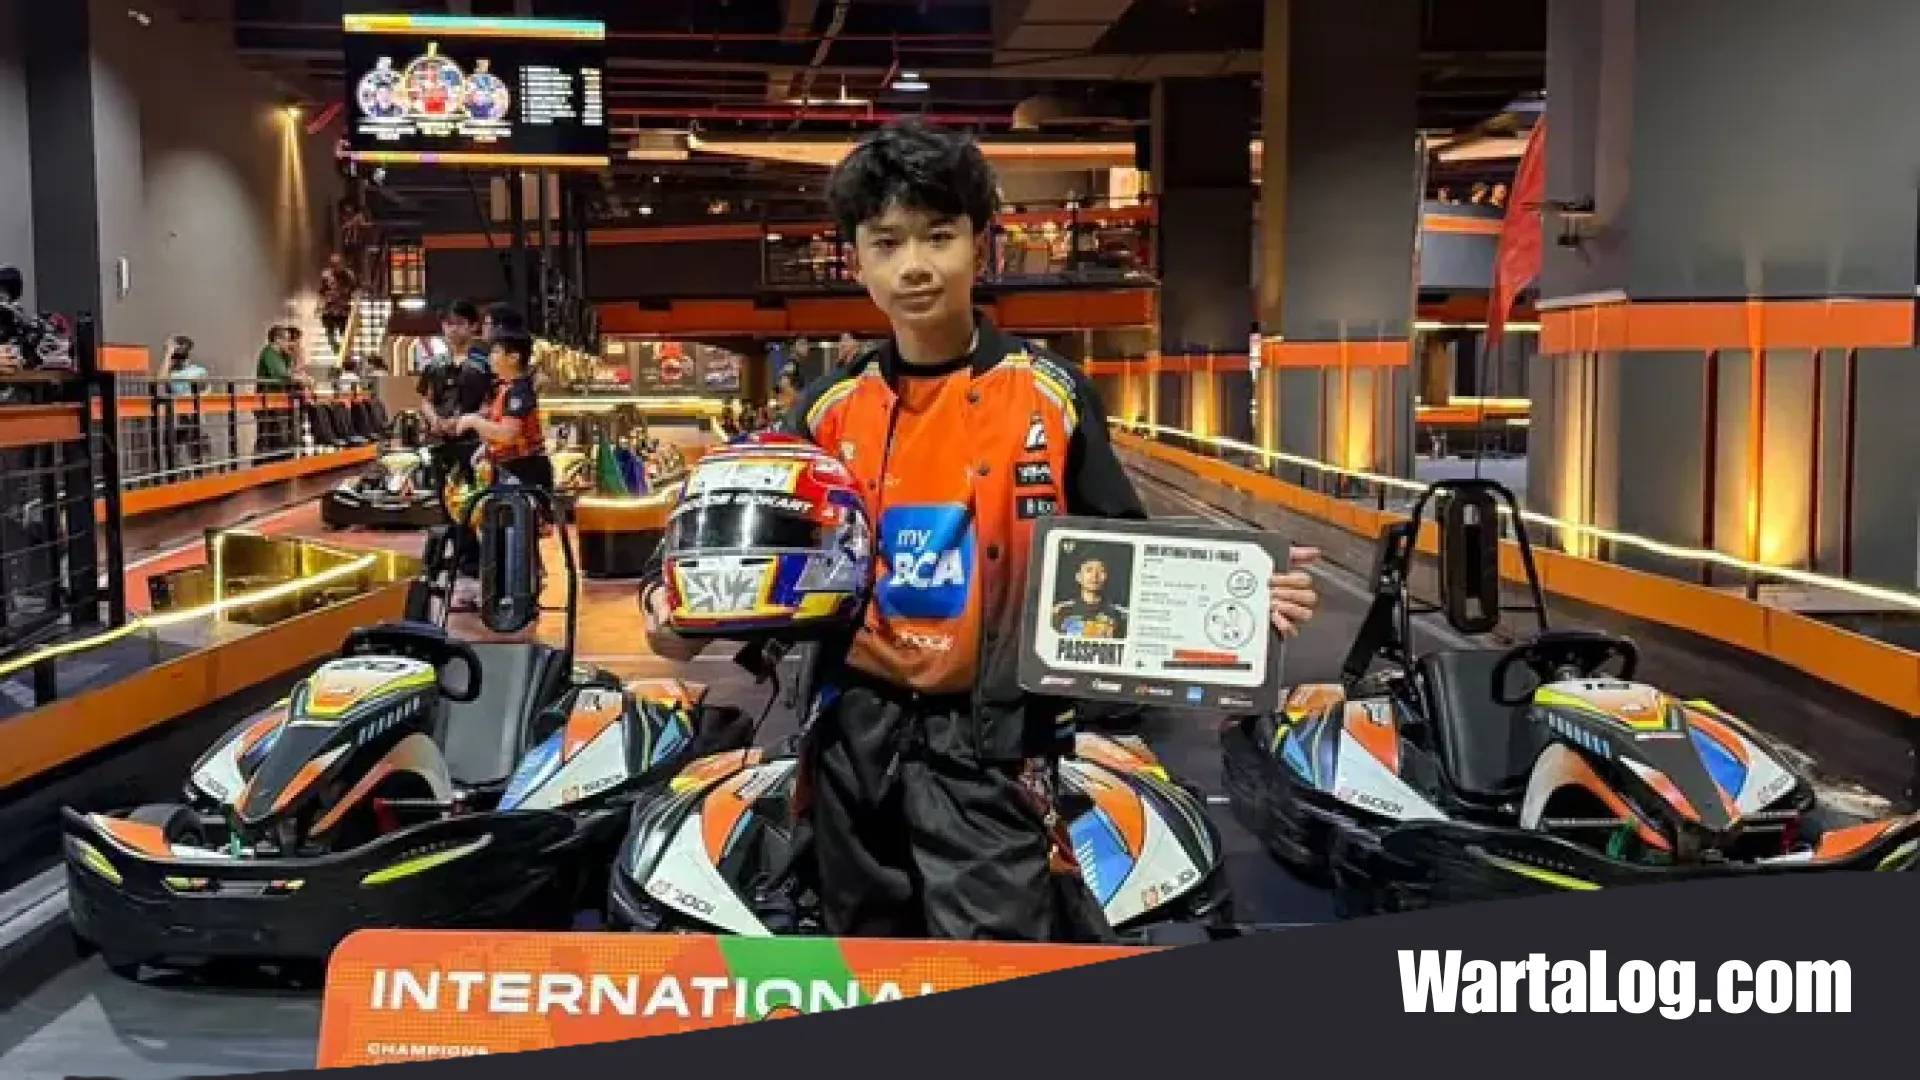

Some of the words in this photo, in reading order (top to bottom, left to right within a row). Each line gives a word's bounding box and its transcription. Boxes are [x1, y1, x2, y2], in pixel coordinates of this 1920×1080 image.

[897, 530, 931, 551] my
[889, 549, 965, 588] BCA
[1057, 638, 1125, 667] PASSPORT
